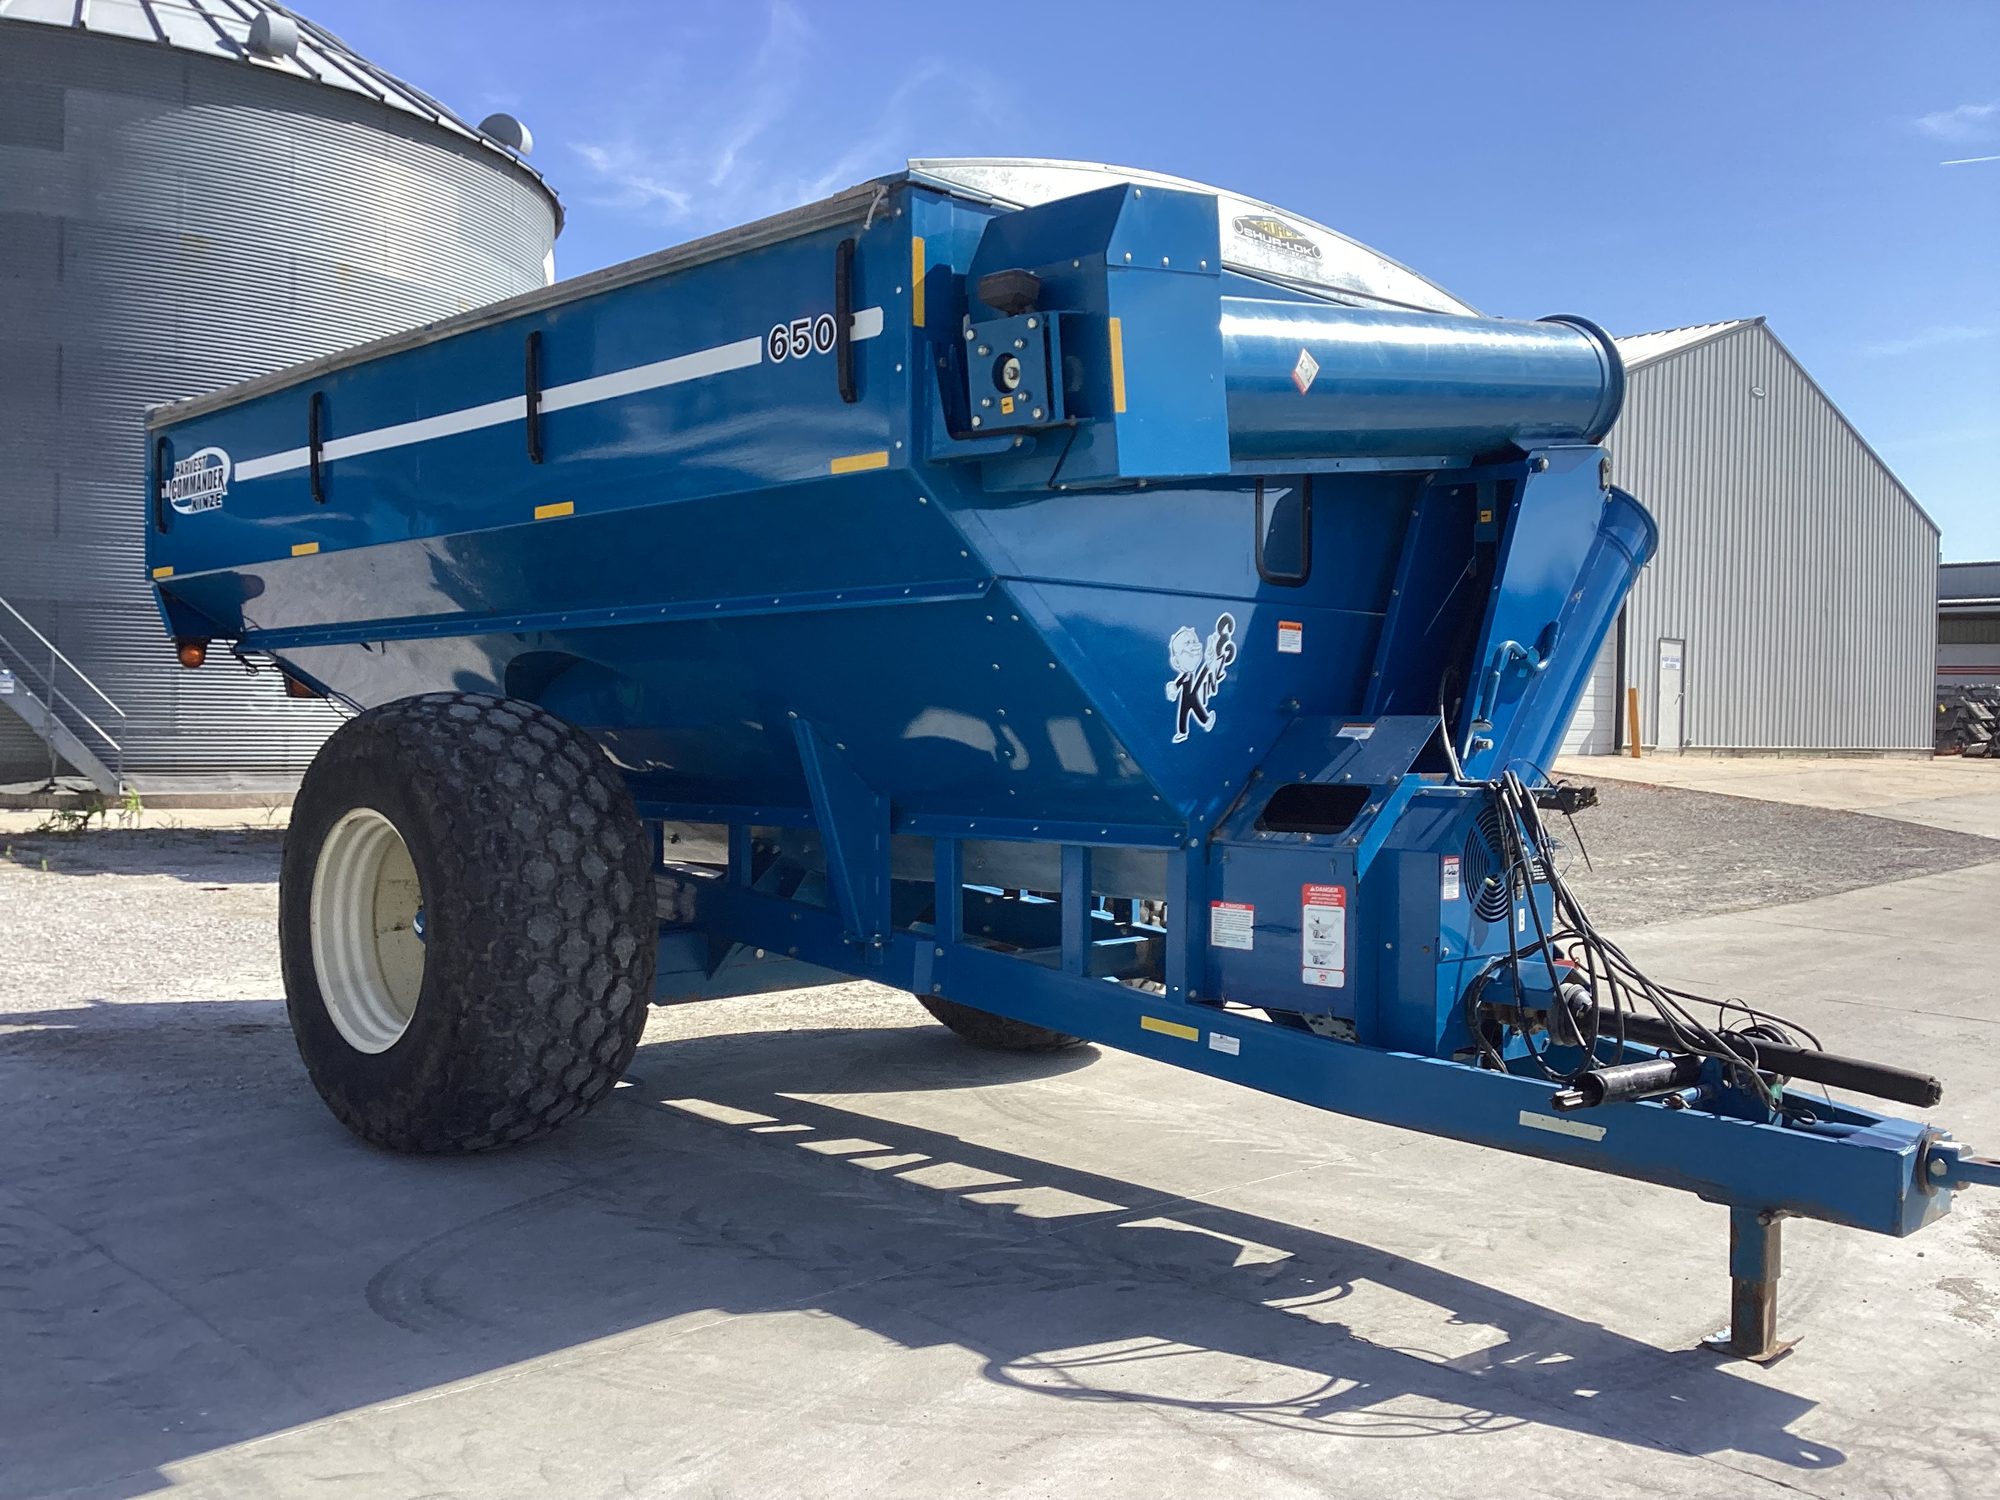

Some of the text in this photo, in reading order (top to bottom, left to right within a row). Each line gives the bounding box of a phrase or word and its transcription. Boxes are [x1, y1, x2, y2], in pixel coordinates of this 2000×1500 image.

[1243, 228, 1313, 257] SHUR-LOK
[768, 313, 837, 363] 650
[175, 455, 207, 476] HARVEST
[171, 468, 227, 500] COMMANDER
[191, 493, 223, 512] KINZE
